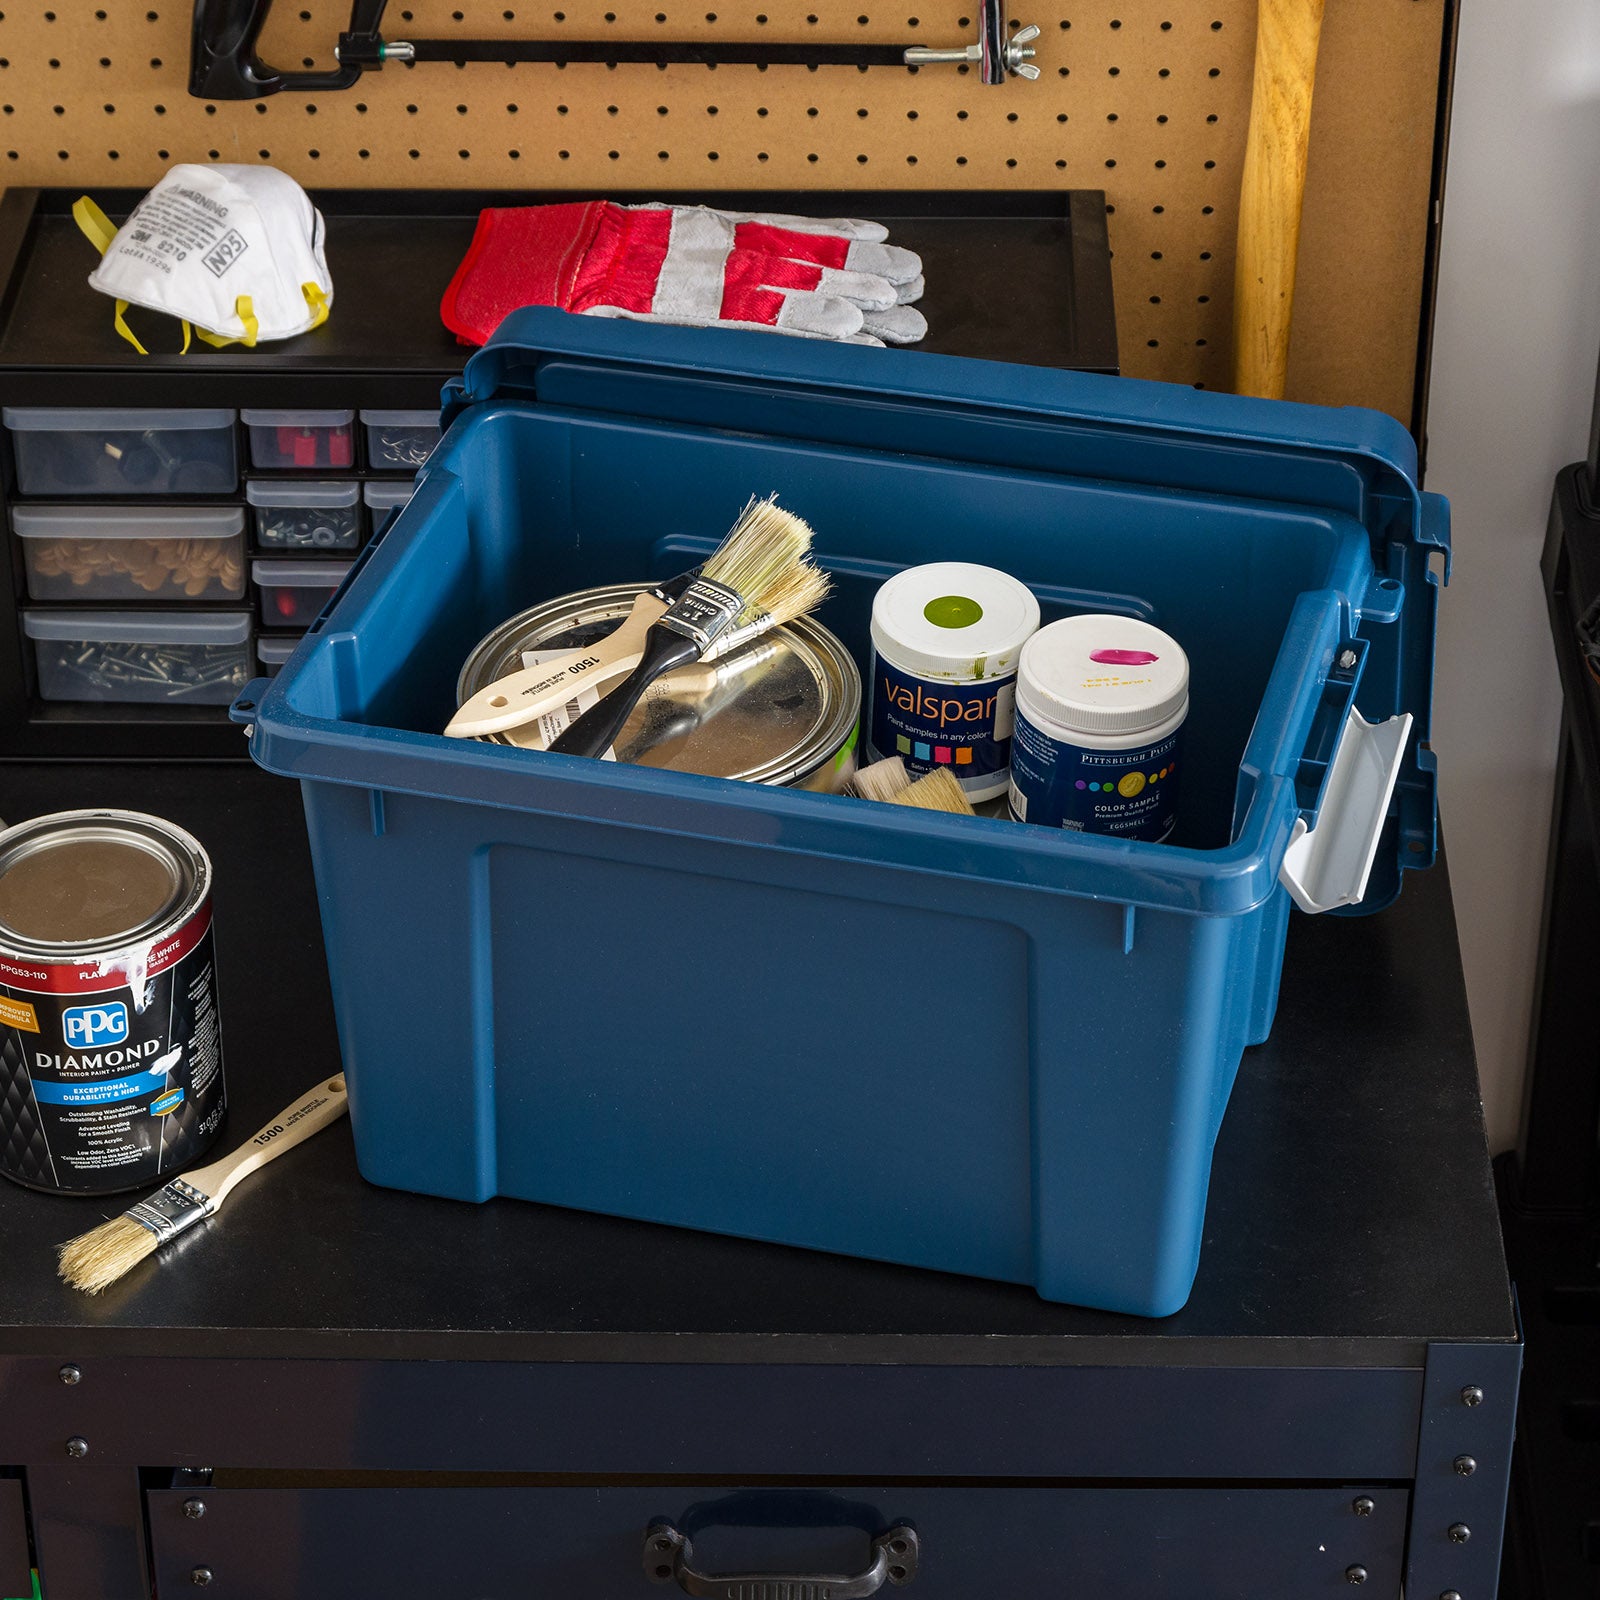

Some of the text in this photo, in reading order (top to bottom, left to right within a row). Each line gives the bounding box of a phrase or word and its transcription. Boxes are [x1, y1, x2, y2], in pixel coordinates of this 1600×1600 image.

[130, 229, 152, 243] 3M
[157, 240, 187, 261] 8210
[207, 234, 242, 272] N95
[568, 656, 600, 674] 1500
[884, 677, 997, 728] valspar
[887, 713, 904, 728] Paint
[904, 723, 938, 739] samples
[939, 732, 949, 740] in
[950, 734, 965, 743] any
[1094, 793, 1160, 812] COLOR SAMPLE
[1109, 818, 1145, 830] EGGSHELL
[157, 939, 181, 959] WHITE
[0, 963, 48, 980] PPG53-110
[67, 1009, 124, 1043] PPG
[60, 1070, 90, 1078] INTERIOR
[116, 1062, 140, 1072] PRIMER
[63, 1092, 112, 1101] DURABILITY
[73, 1082, 129, 1094] EXCEPTIONAL
[103, 1105, 137, 1114] Washability,
[118, 1107, 147, 1118] Resistance
[106, 1121, 130, 1129] Leveling
[103, 1137, 123, 1145] Acrylic
[253, 1124, 284, 1147] 1500
